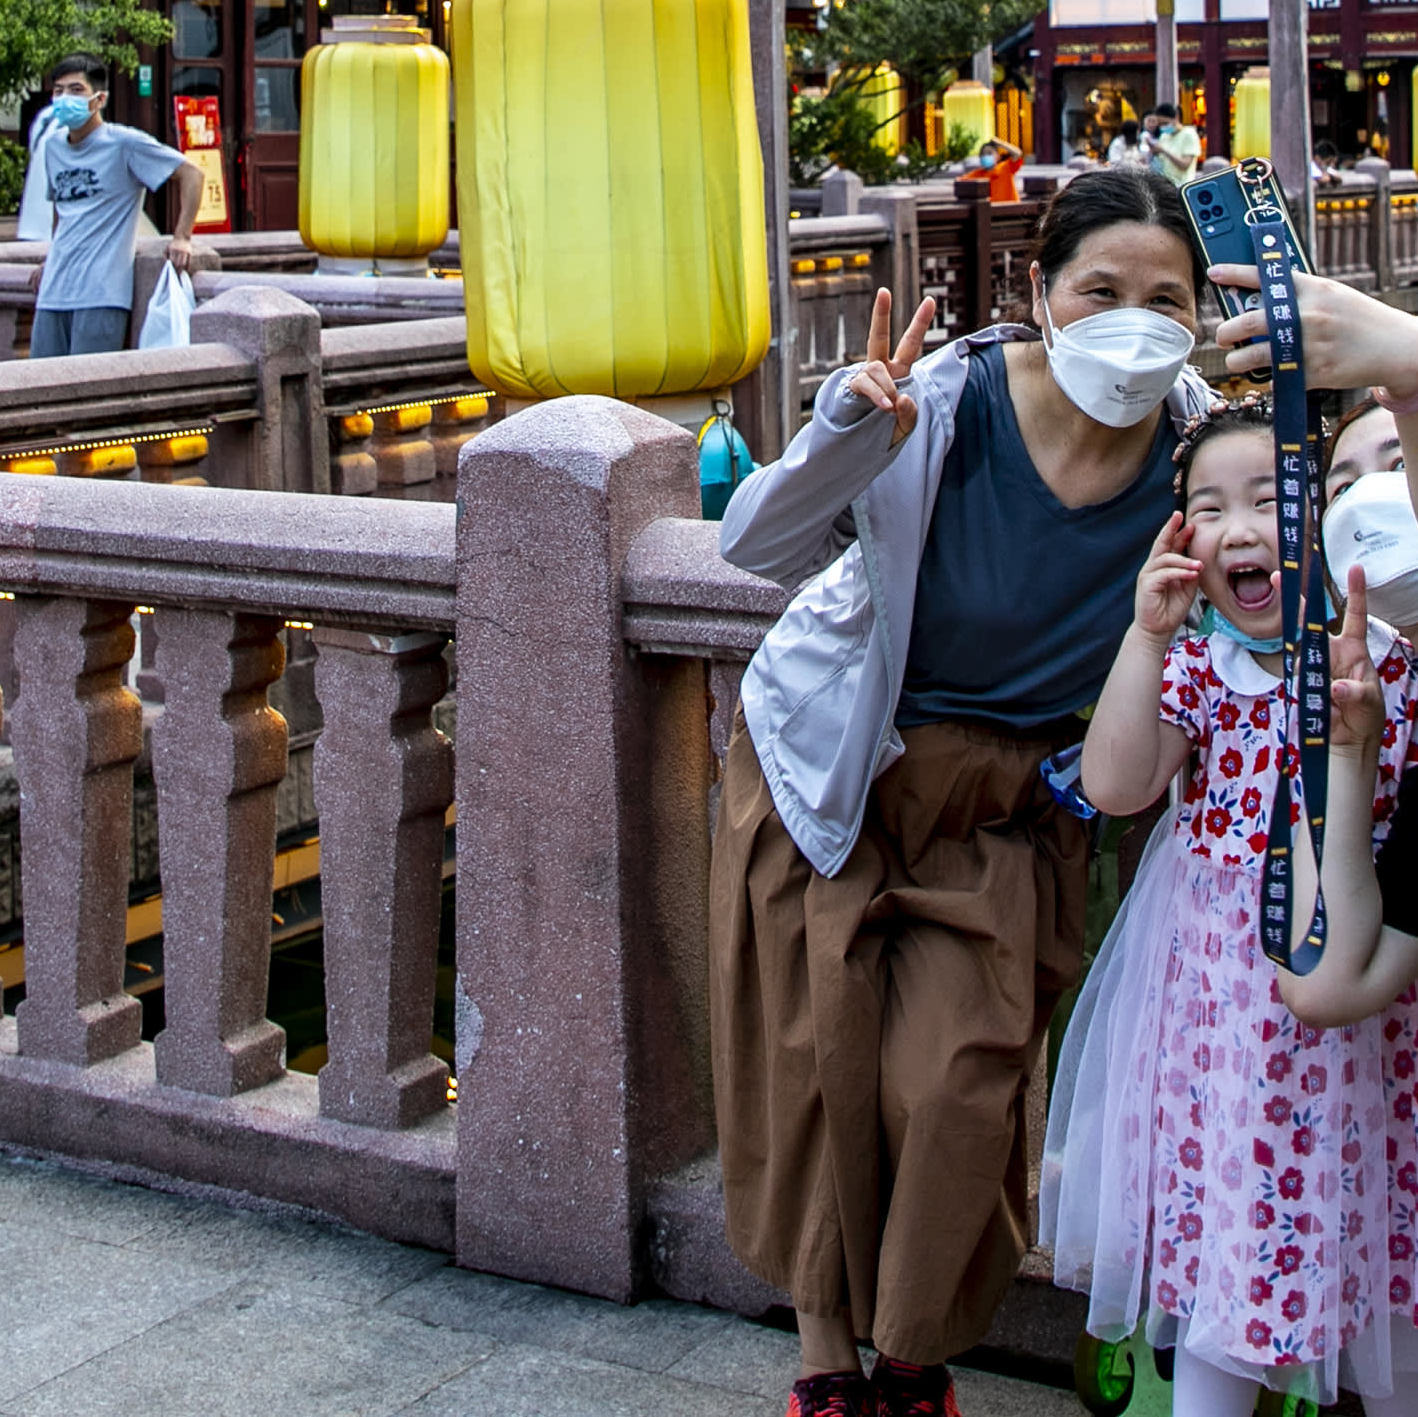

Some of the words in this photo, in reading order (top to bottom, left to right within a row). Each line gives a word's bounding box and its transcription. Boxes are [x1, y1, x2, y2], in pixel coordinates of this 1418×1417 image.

[1265, 262, 1294, 344] 忙着赚钱
[1283, 455, 1300, 543] 忙着赚钱
[1266, 859, 1287, 944] 忙着赚钱
